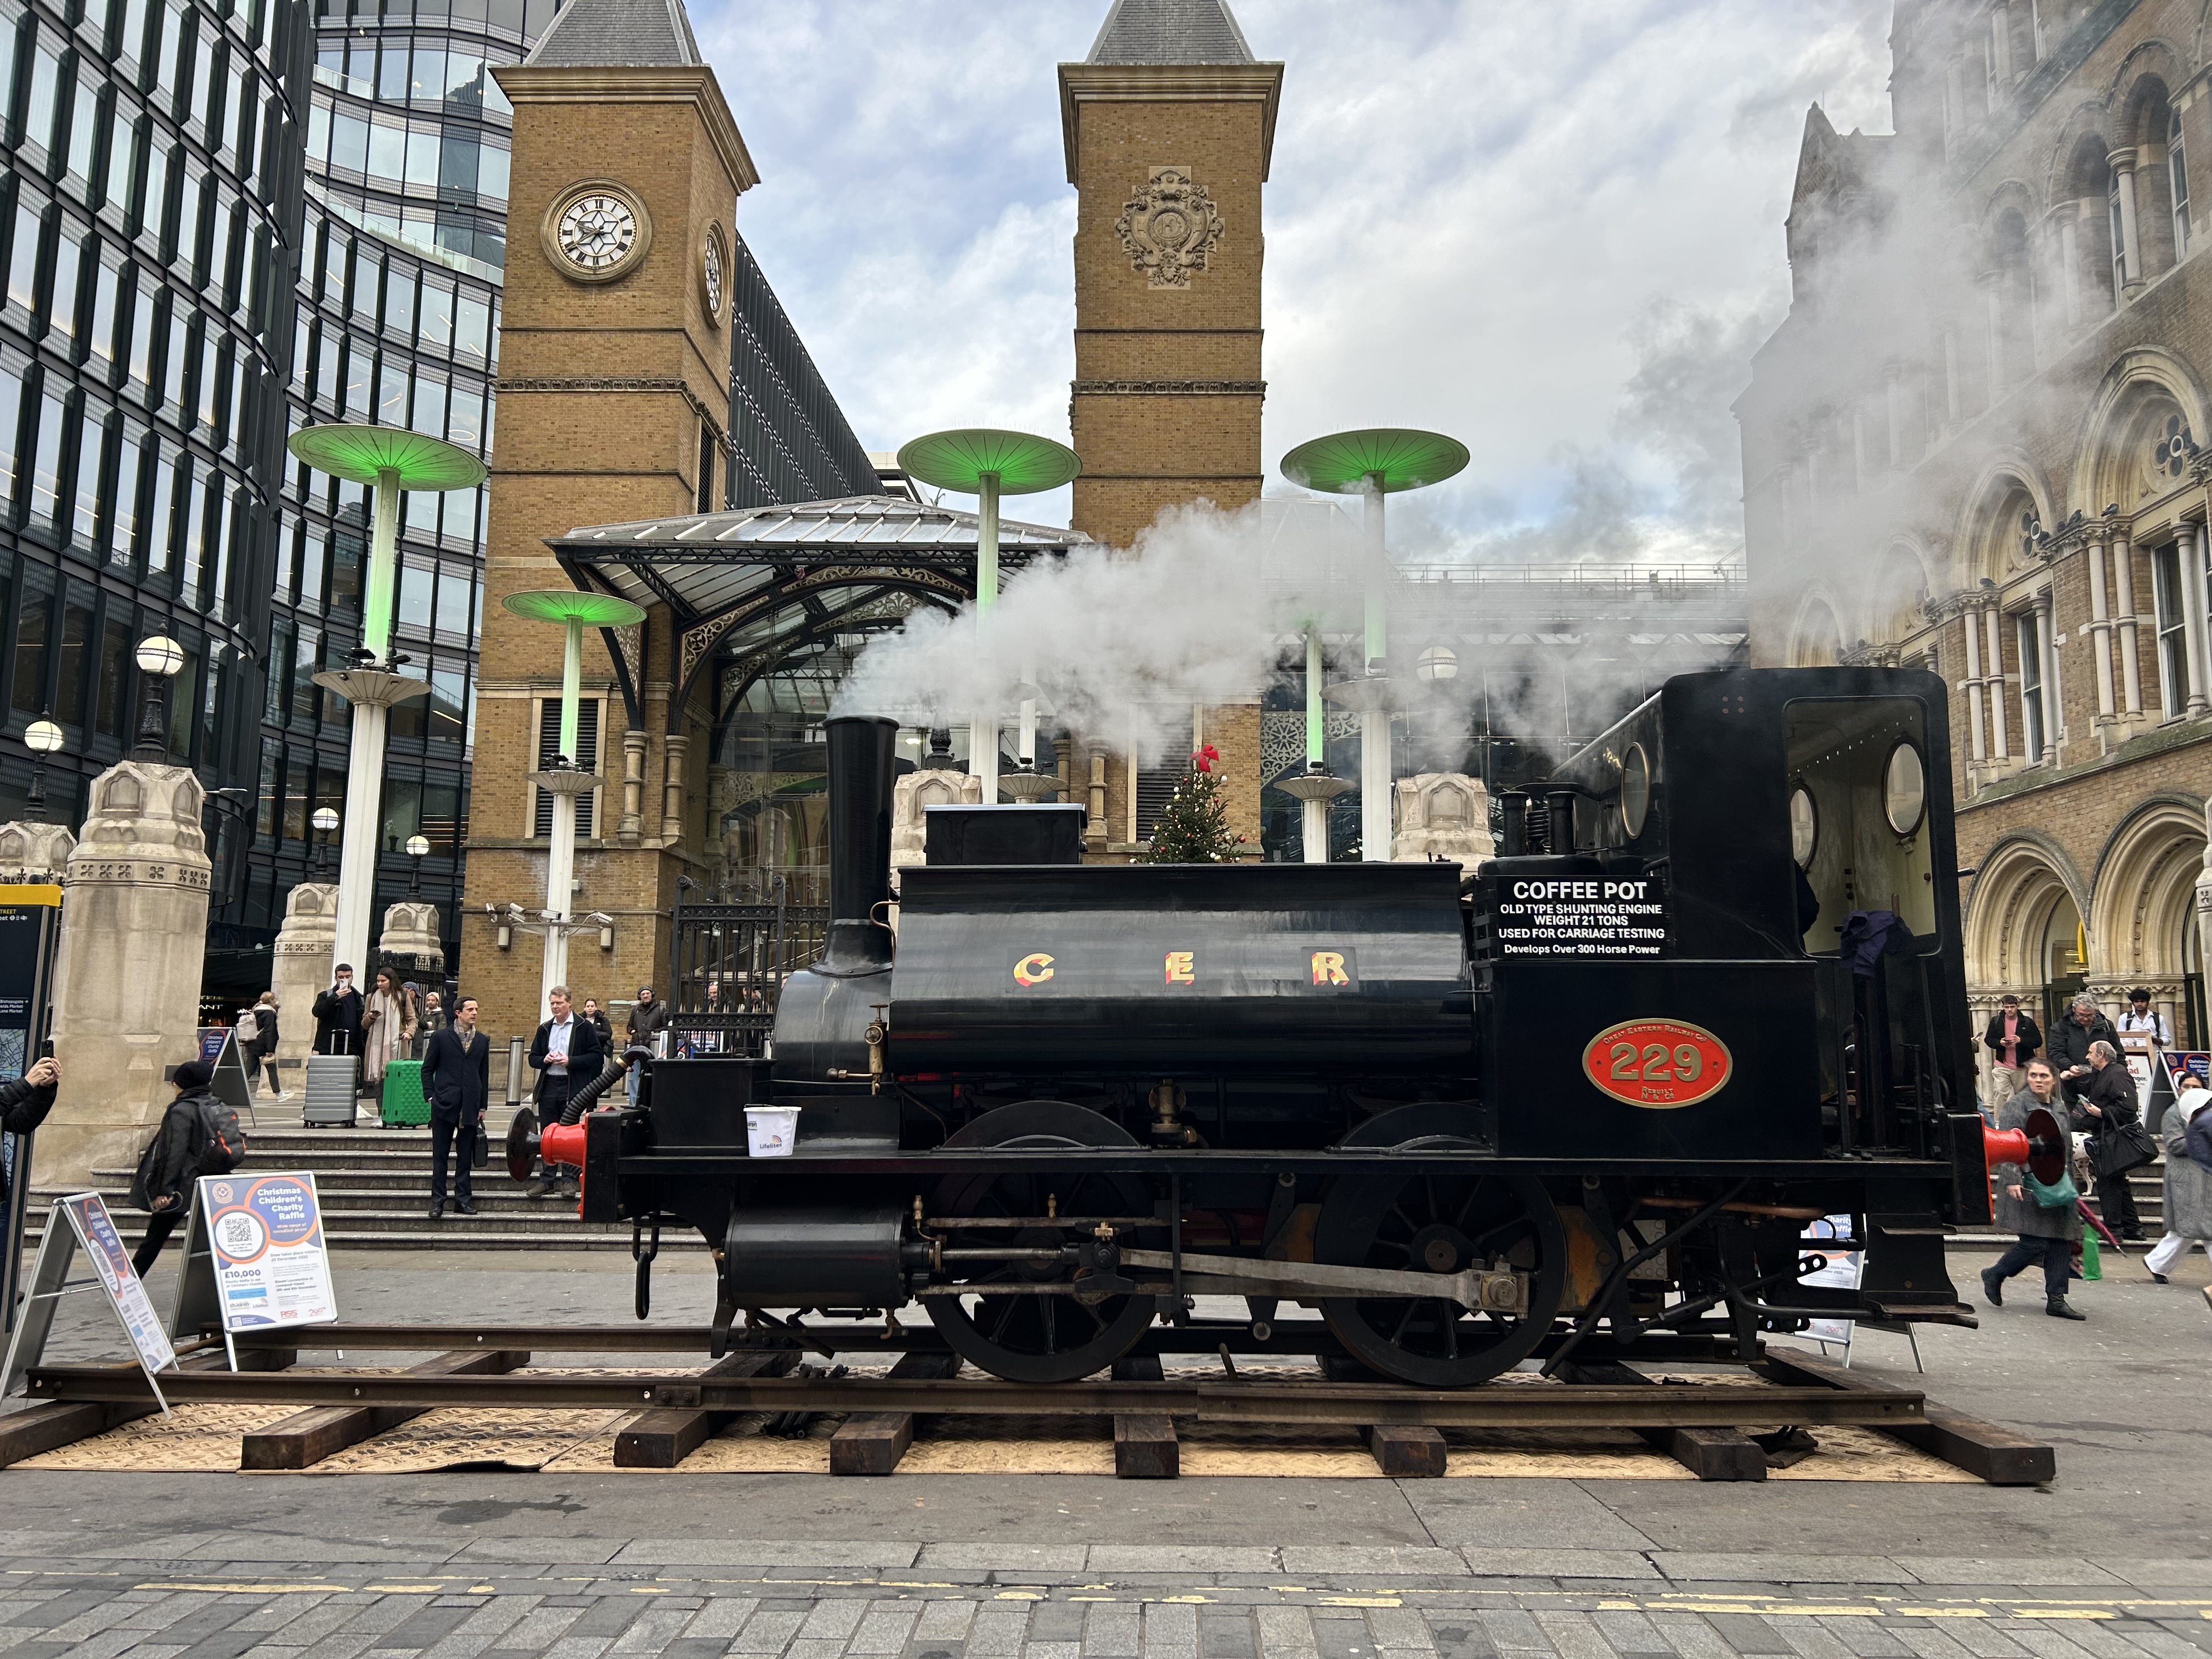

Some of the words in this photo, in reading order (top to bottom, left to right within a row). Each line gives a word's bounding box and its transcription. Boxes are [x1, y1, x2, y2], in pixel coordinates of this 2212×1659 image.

[1513, 882, 1598, 900] COFFEE
[1604, 881, 1647, 900] POT
[1500, 904, 1524, 914] OLD
[1525, 904, 1554, 914] TYPE
[1555, 904, 1616, 914] SHUNTING
[1618, 904, 1663, 915] ENGINE
[1534, 915, 1580, 926] WEIGHT
[1582, 916, 1593, 926] 21
[1596, 915, 1628, 926] TONS
[1498, 928, 1531, 938] USED
[1532, 928, 1556, 938] FOR
[1557, 928, 1616, 939] CARRIAGE
[1617, 928, 1665, 939] TESTING
[1504, 944, 1550, 955] Develops
[1553, 944, 1577, 953] Over
[1577, 944, 1595, 953] 300
[1597, 944, 1627, 954] Horse
[1628, 944, 1660, 954] Power
[1013, 953, 1054, 988] G
[1165, 952, 1195, 985] E
[1311, 952, 1350, 986] R
[1603, 1030, 1625, 1045] GREAT
[1610, 1042, 1702, 1082] 229
[257, 1188, 301, 1196] Christmas
[258, 1195, 303, 1204] Children's
[271, 1204, 303, 1212] Charity
[278, 1211, 305, 1220] Raffle
[224, 1269, 261, 1278] £10,000
